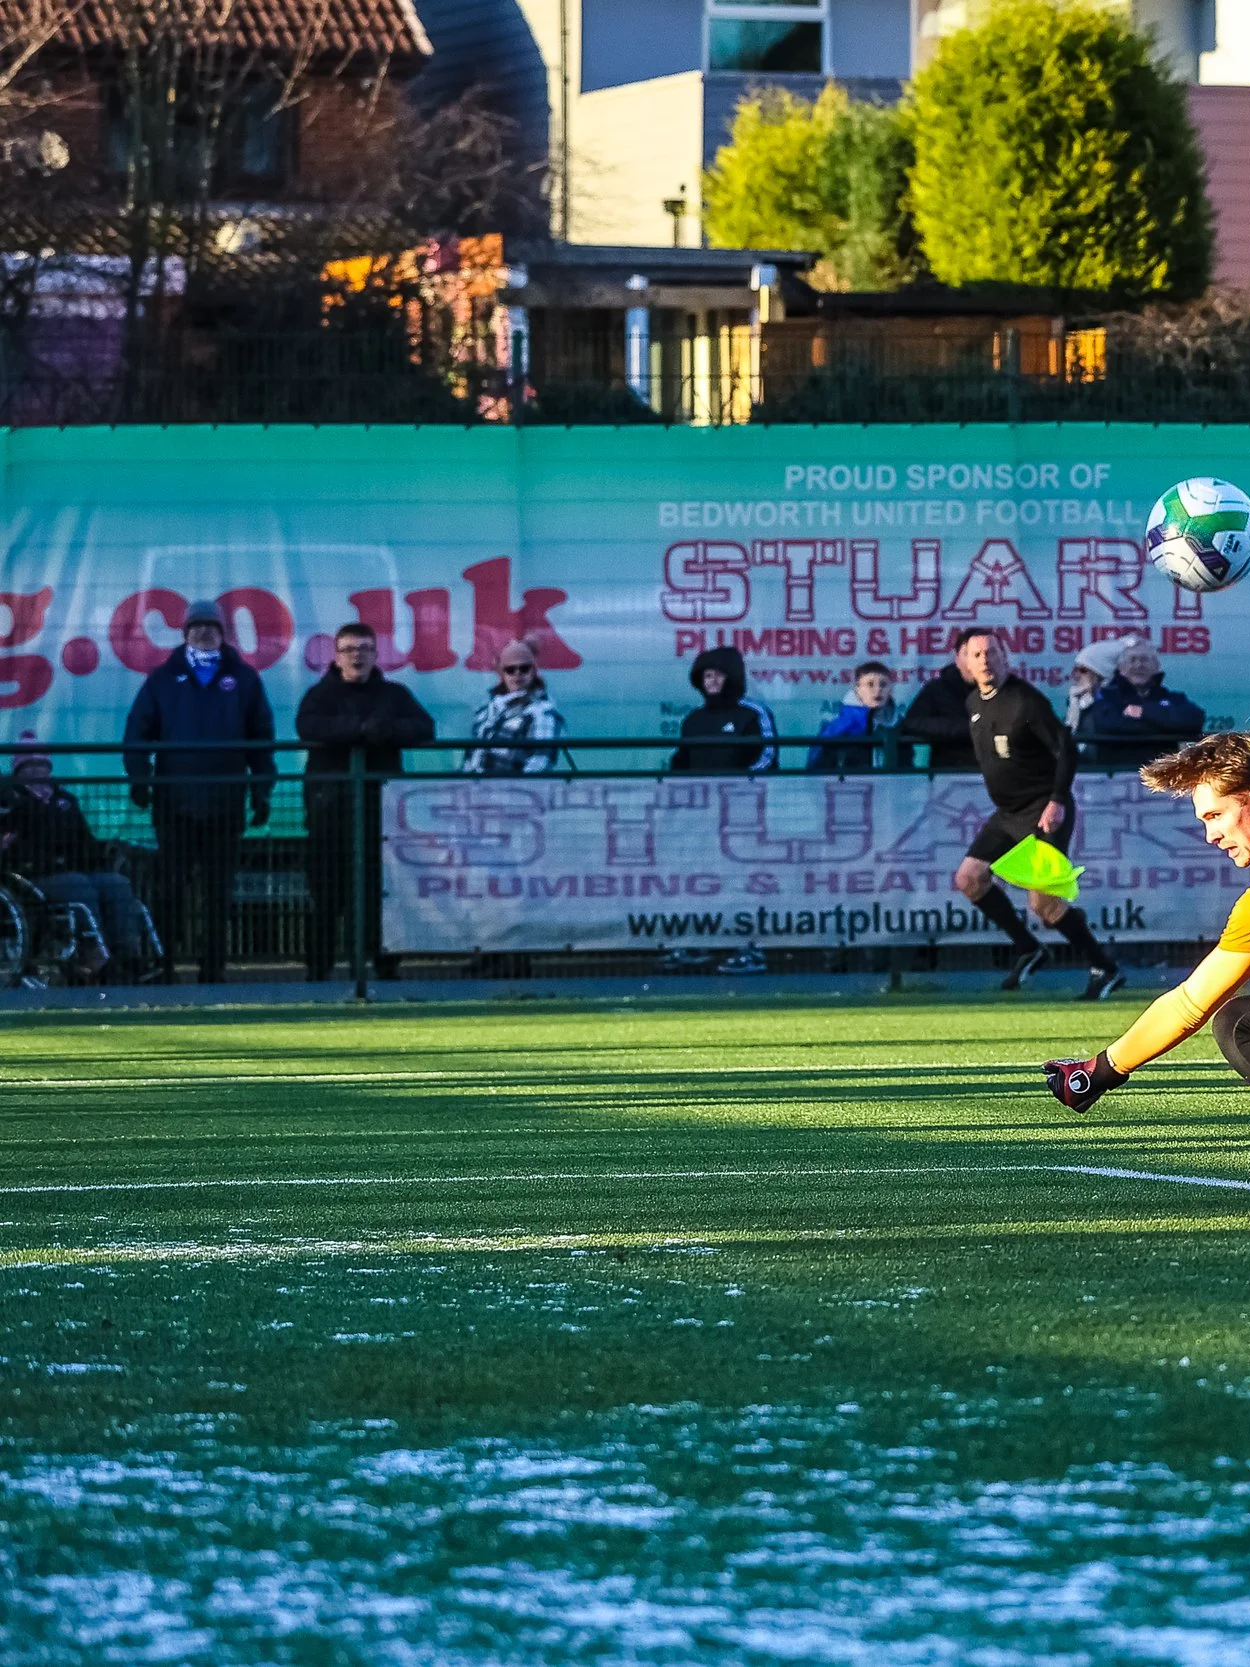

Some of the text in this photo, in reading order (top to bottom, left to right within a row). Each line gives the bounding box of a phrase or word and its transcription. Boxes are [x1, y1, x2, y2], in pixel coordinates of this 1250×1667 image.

[784, 463, 1112, 491] PROUD SPONSOR OF
[658, 498, 1142, 527] BEDWORTH UNITED FOOTBALL
[676, 628, 857, 657] PLUMBING
[867, 627, 892, 655] &
[900, 626, 1045, 654] HEANG
[392, 783, 1228, 867] STUAR
[418, 866, 1248, 898] PLUMBING & HEATI SUPPL
[628, 899, 1146, 942] www.stuartplumbi..uk
